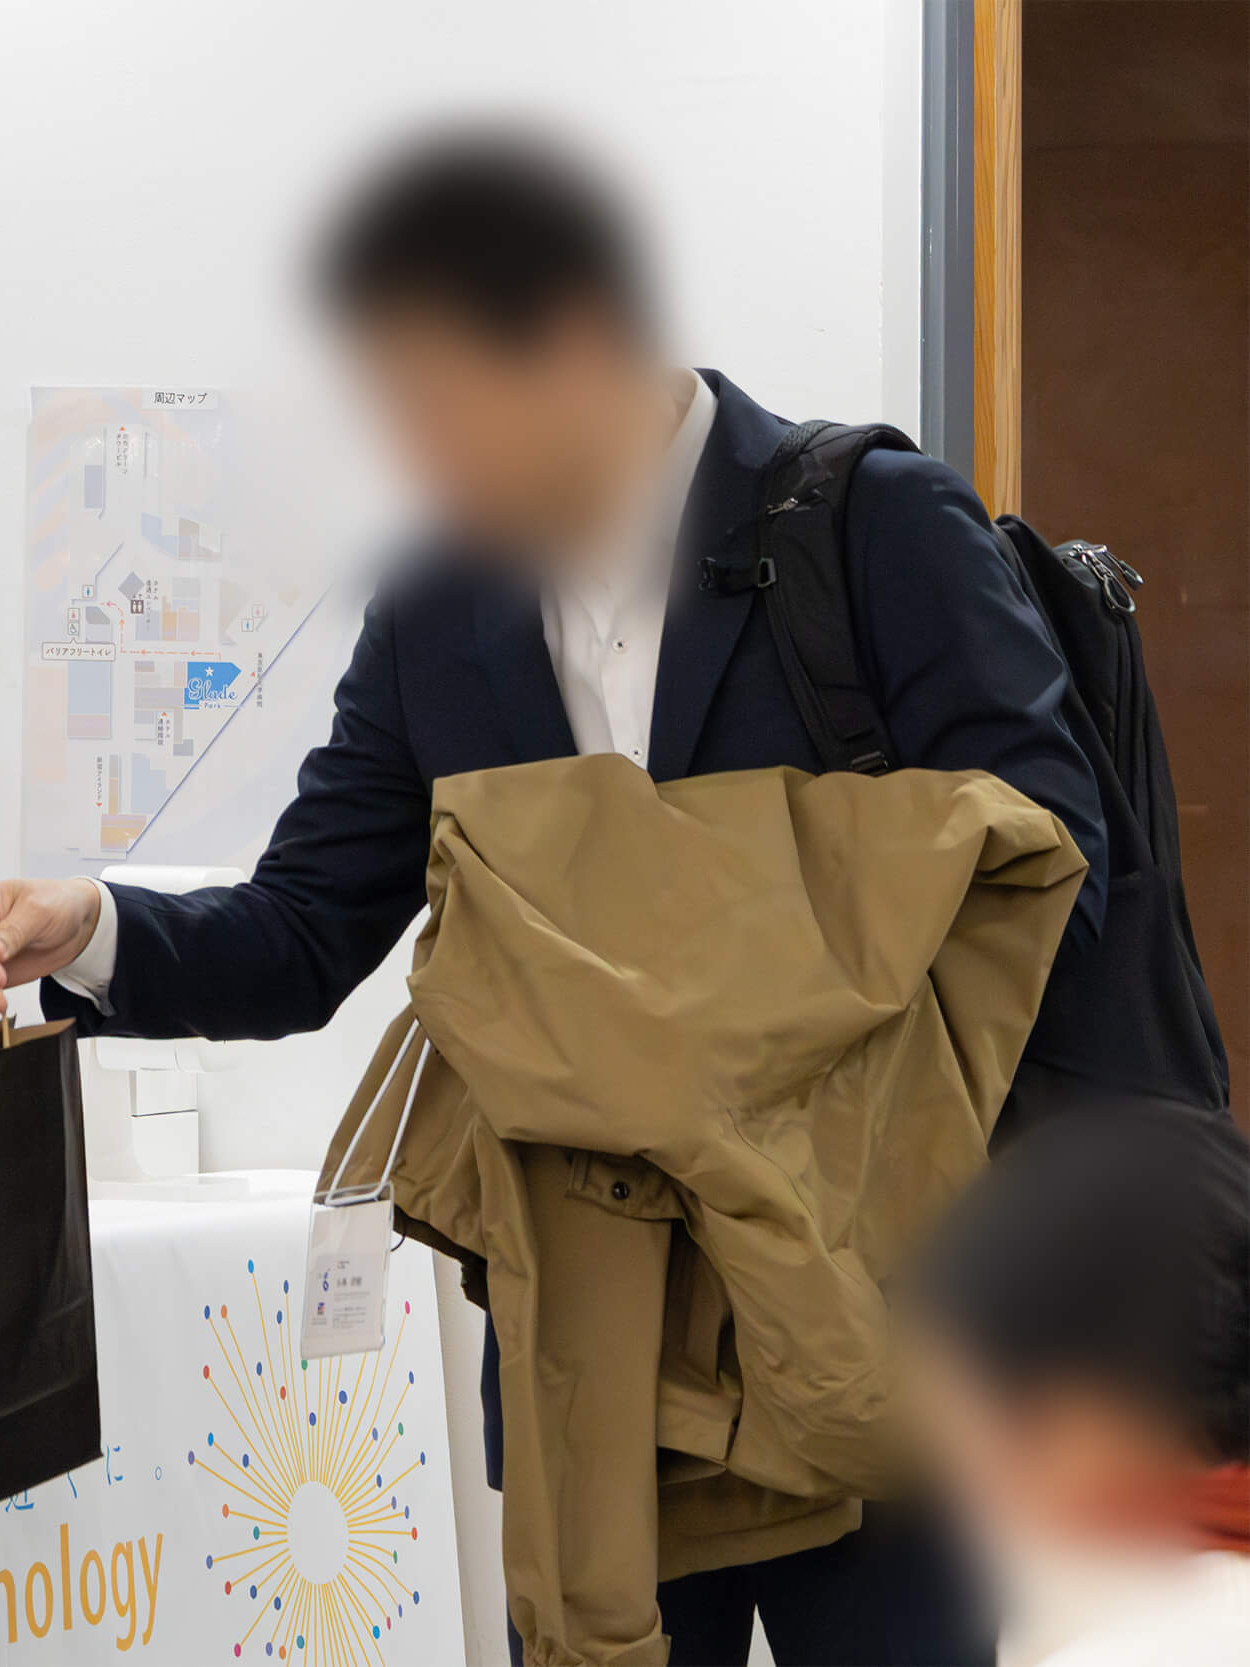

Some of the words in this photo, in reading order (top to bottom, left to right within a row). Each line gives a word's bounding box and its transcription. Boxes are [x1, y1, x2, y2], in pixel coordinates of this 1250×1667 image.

[154, 392, 208, 405] 周辺マップ
